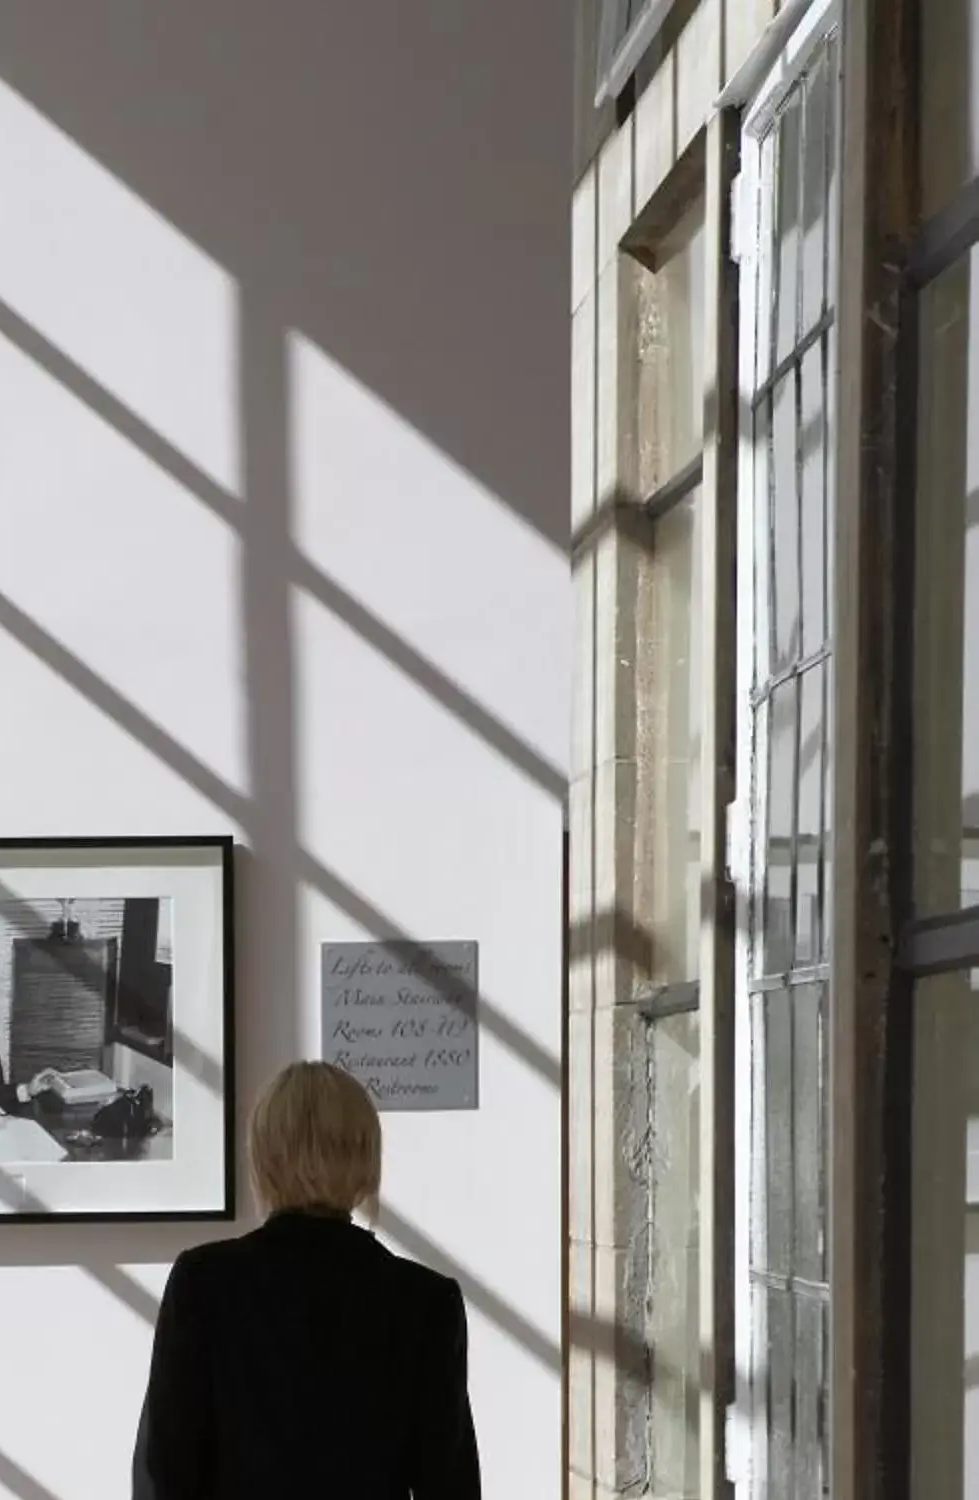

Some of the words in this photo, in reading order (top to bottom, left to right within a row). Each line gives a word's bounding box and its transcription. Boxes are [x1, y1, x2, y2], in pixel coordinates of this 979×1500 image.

[335, 989, 384, 1007] Main
[331, 1018, 383, 1043] Rooms
[331, 1048, 417, 1071] Restaurant
[366, 1076, 439, 1099] Restrooms
